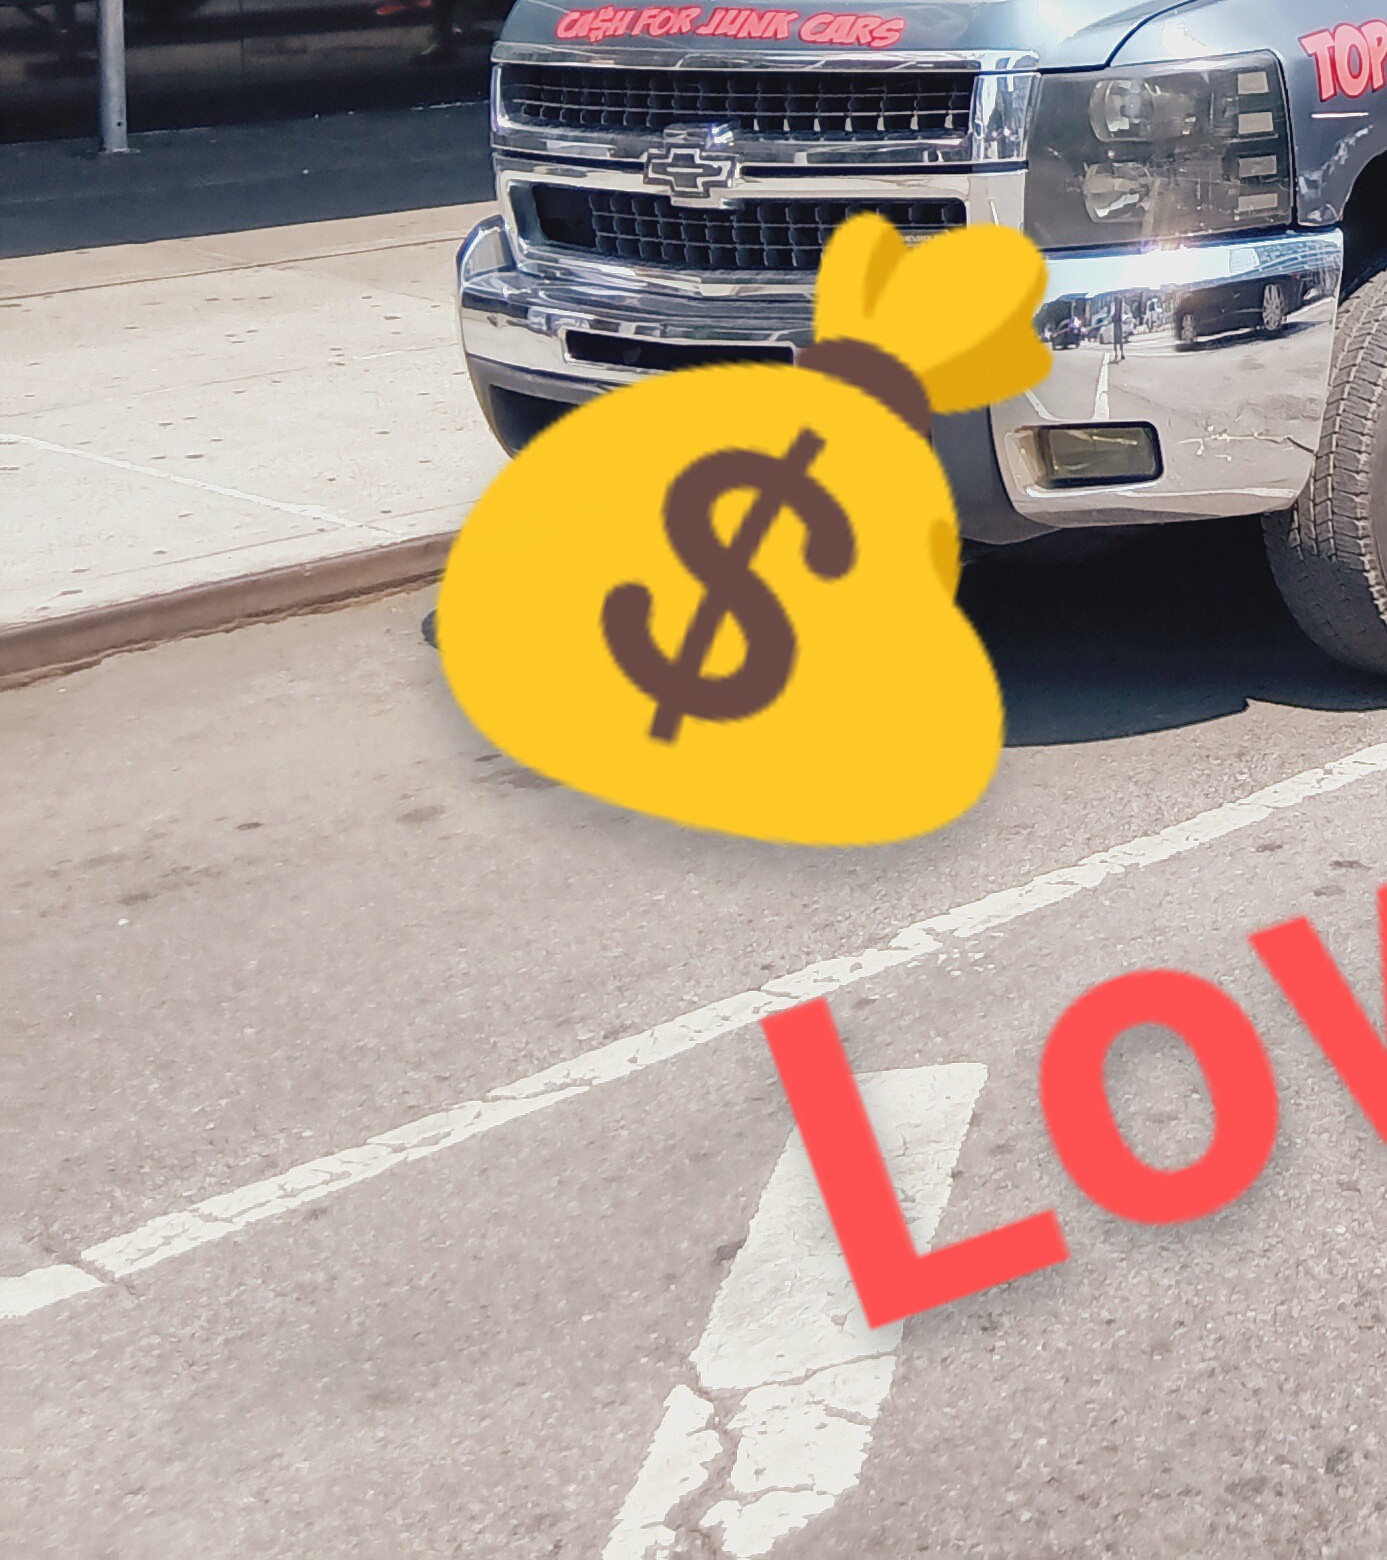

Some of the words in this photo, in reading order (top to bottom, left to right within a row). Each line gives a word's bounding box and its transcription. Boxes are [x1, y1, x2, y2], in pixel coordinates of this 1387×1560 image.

[632, 5, 702, 38] FOR
[696, 5, 799, 40] JUNK
[799, 12, 906, 49] CARS
